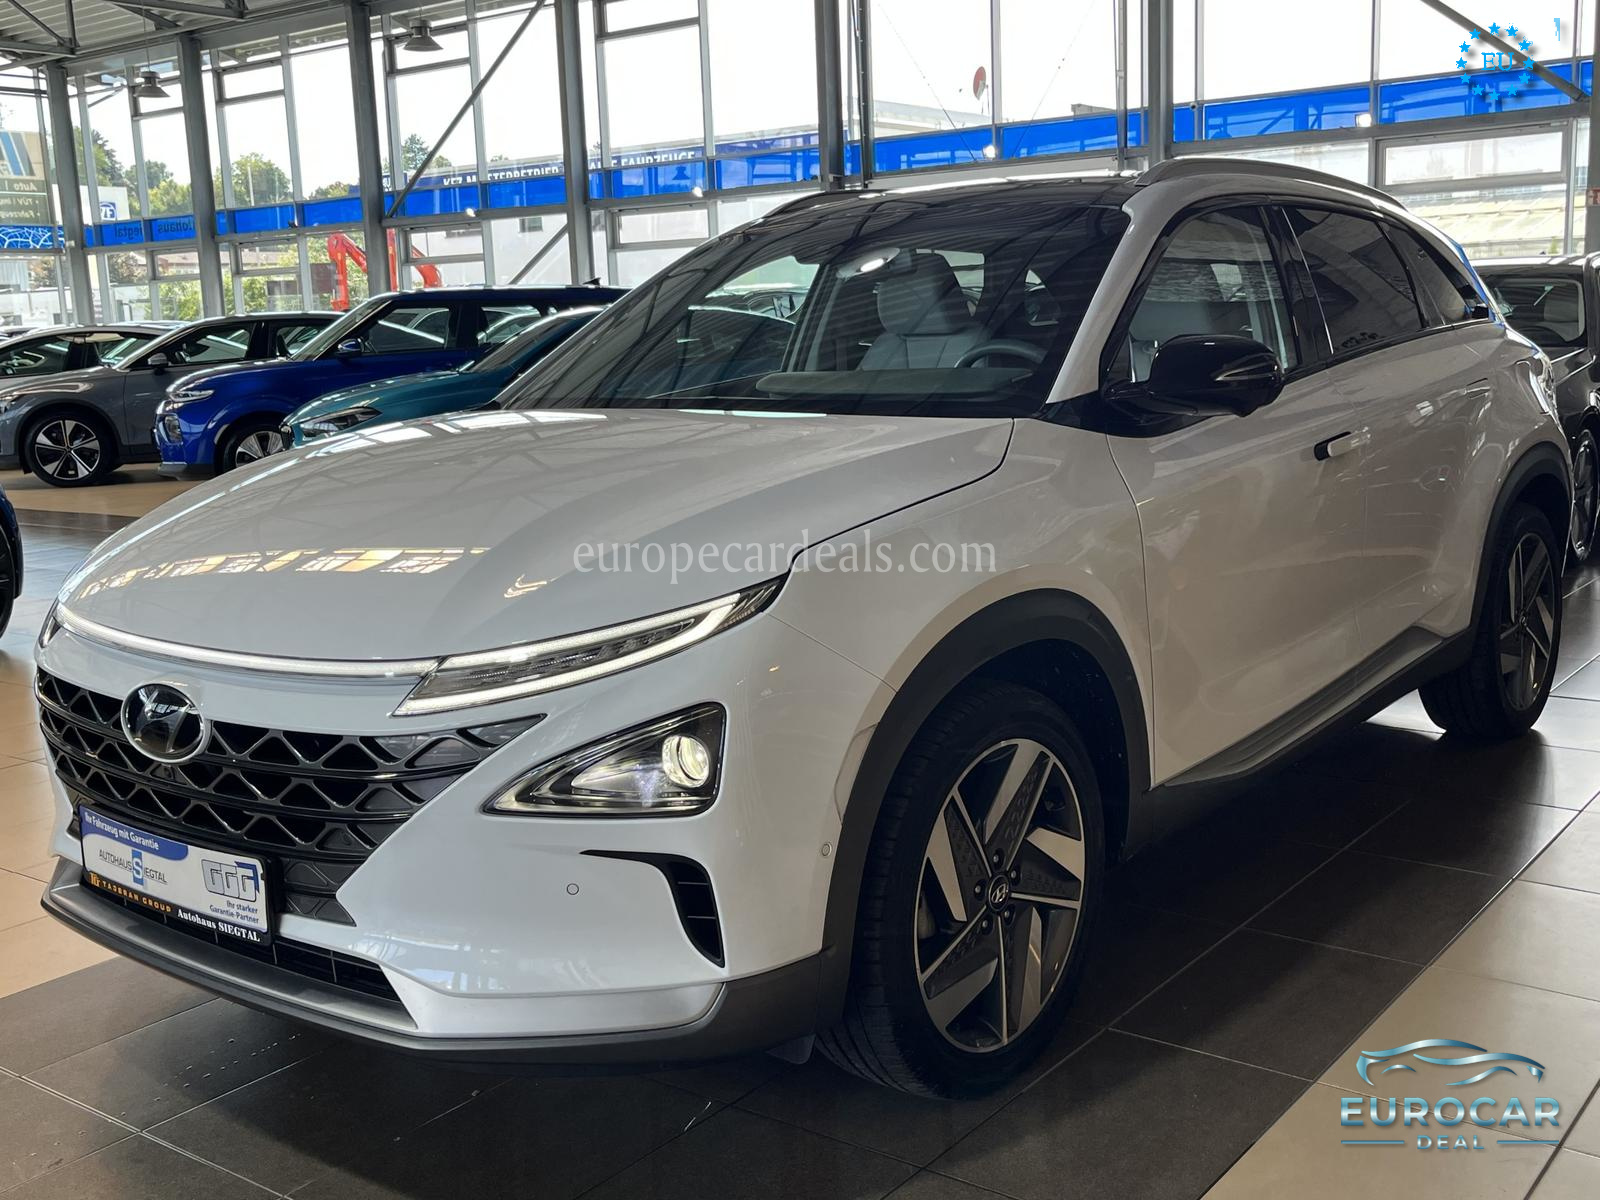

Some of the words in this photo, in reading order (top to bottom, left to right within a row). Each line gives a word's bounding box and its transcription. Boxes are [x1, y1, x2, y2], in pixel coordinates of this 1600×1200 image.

[92, 815, 119, 838] Fahrzeug
[119, 829, 130, 840] mit
[129, 831, 160, 850] Garantie
[98, 849, 133, 871] AUTOHAUS
[209, 904, 259, 924] Garantie-Partner
[227, 900, 235, 909] Ihr
[236, 903, 258, 914] starker
[177, 908, 217, 929] Autohaus
[218, 921, 261, 942] SIEGTAL
